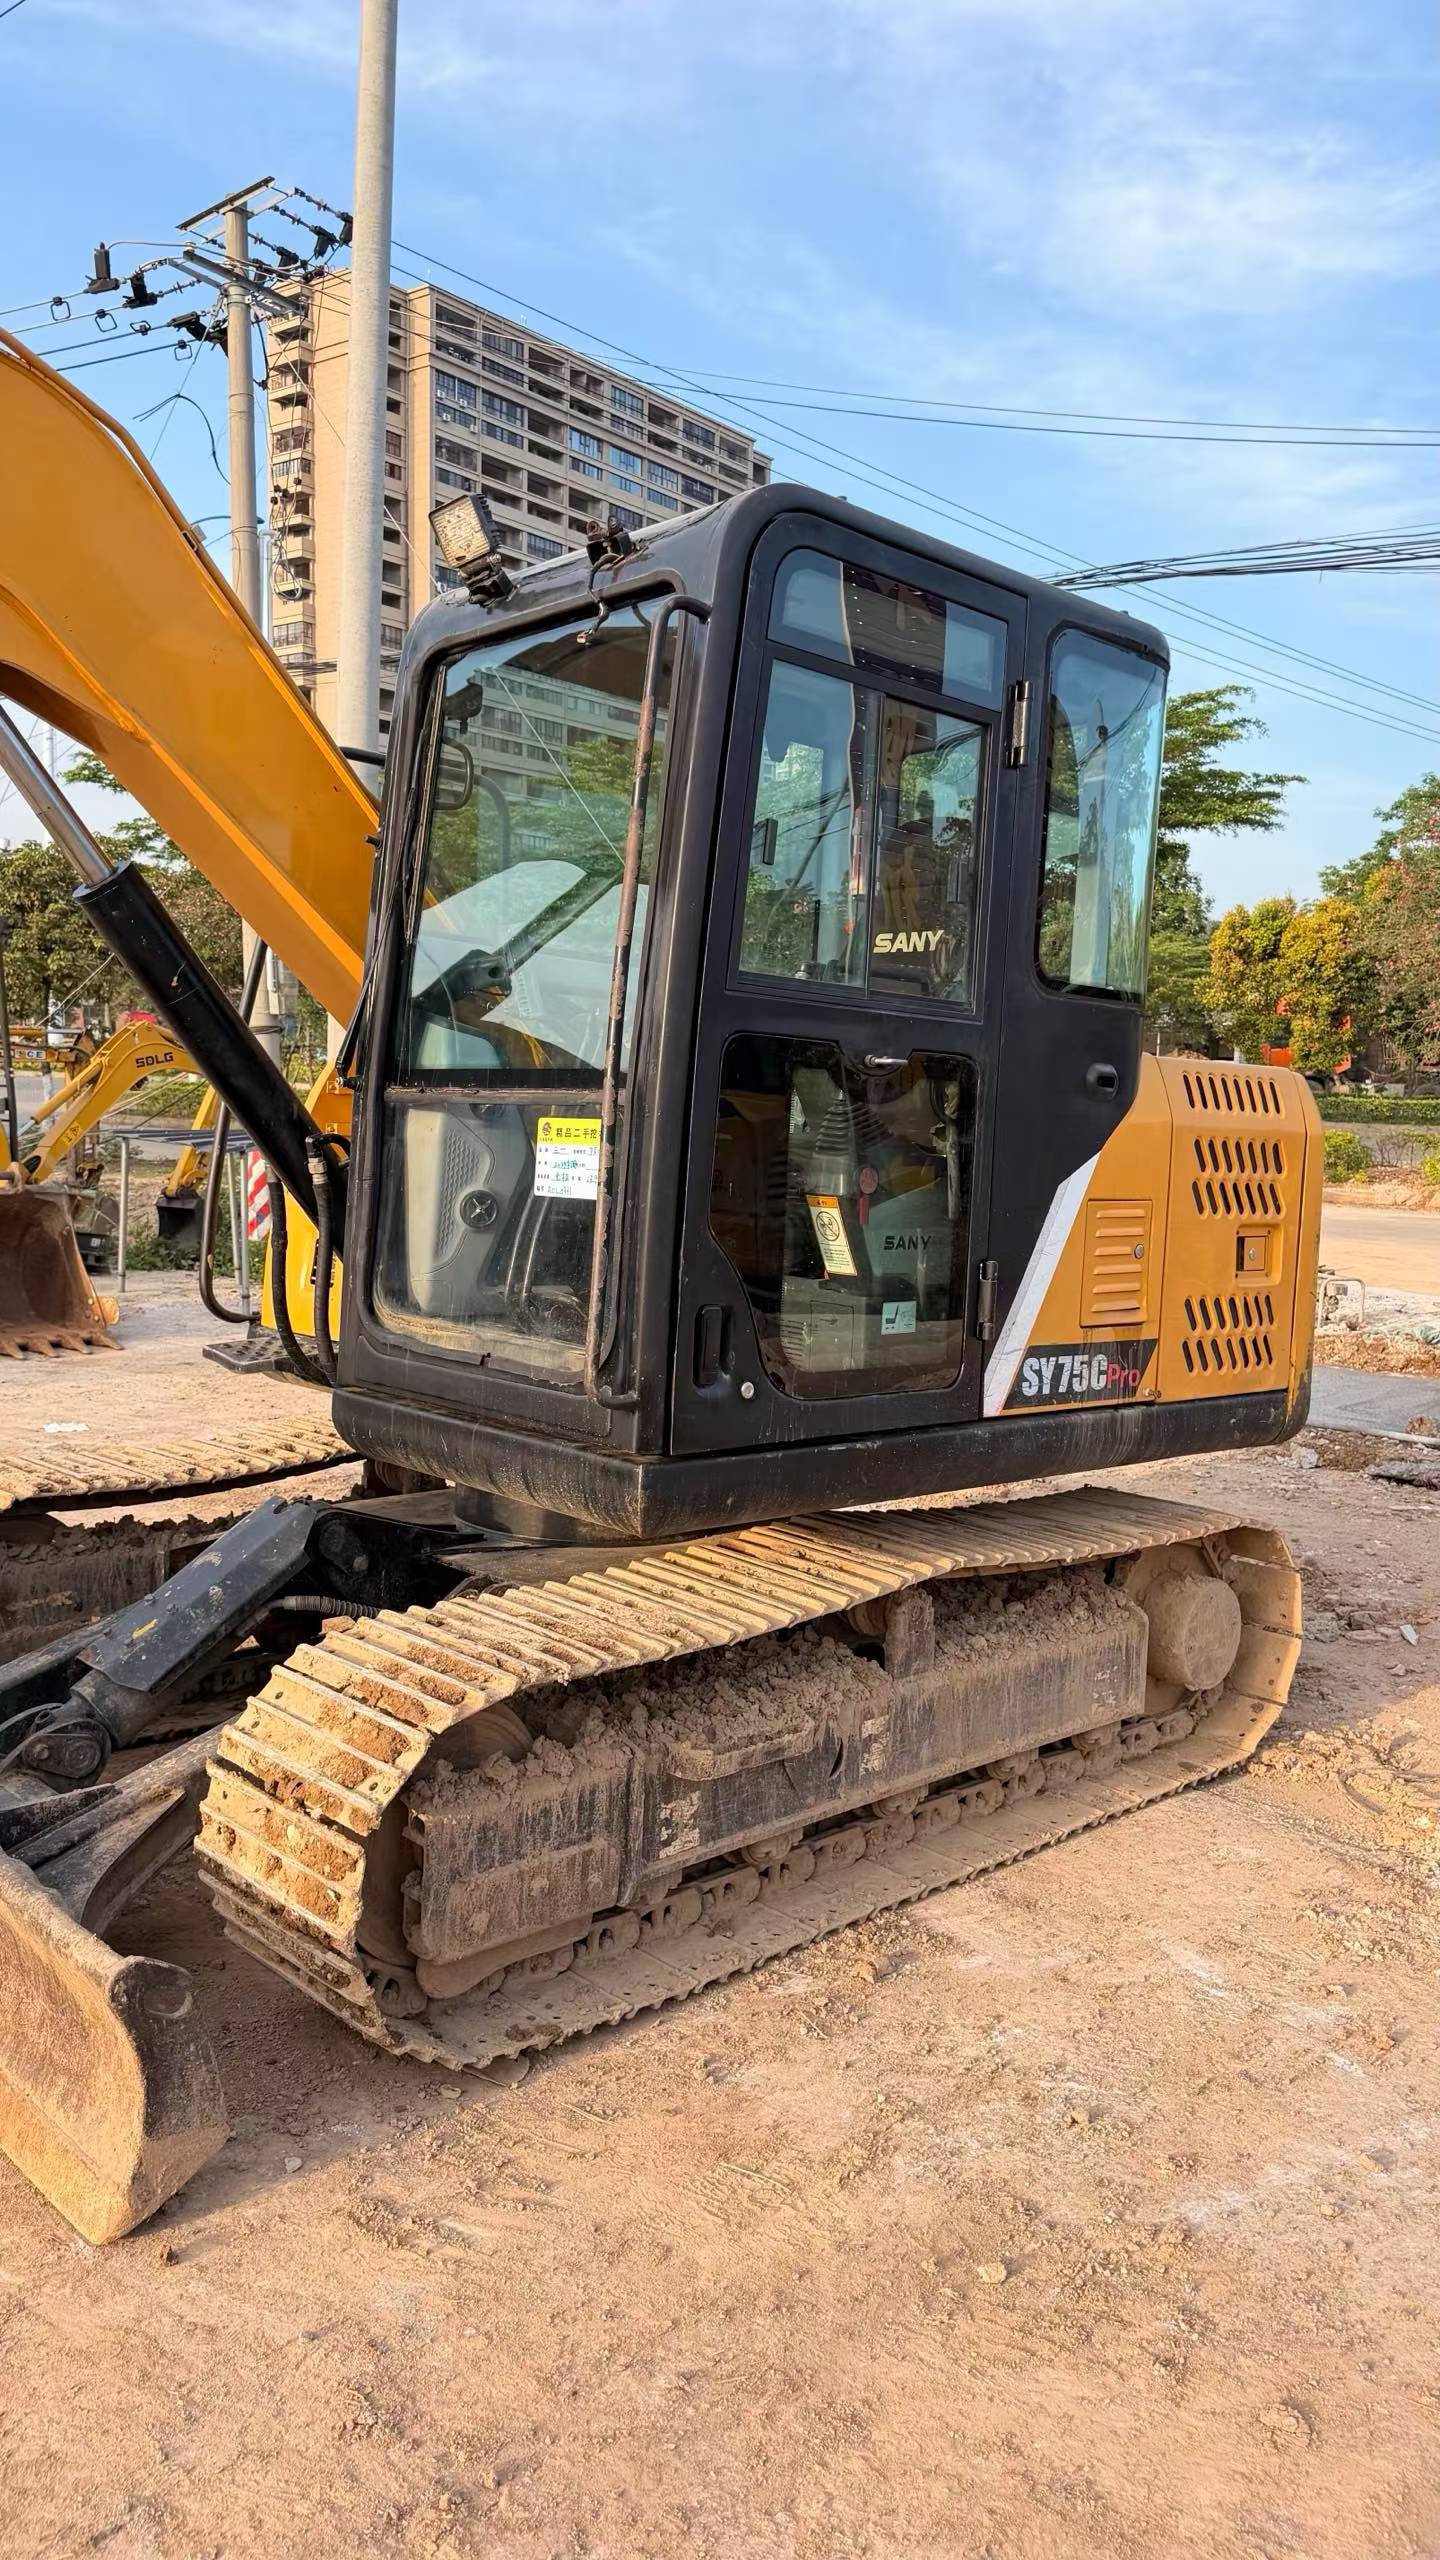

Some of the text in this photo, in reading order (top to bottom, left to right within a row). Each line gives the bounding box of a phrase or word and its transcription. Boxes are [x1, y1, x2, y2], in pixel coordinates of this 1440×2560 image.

[873, 930, 944, 953] SANY
[135, 1052, 174, 1068] SDLG
[556, 1127, 602, 1139] 精品二手挖
[884, 1235, 931, 1250] SANY
